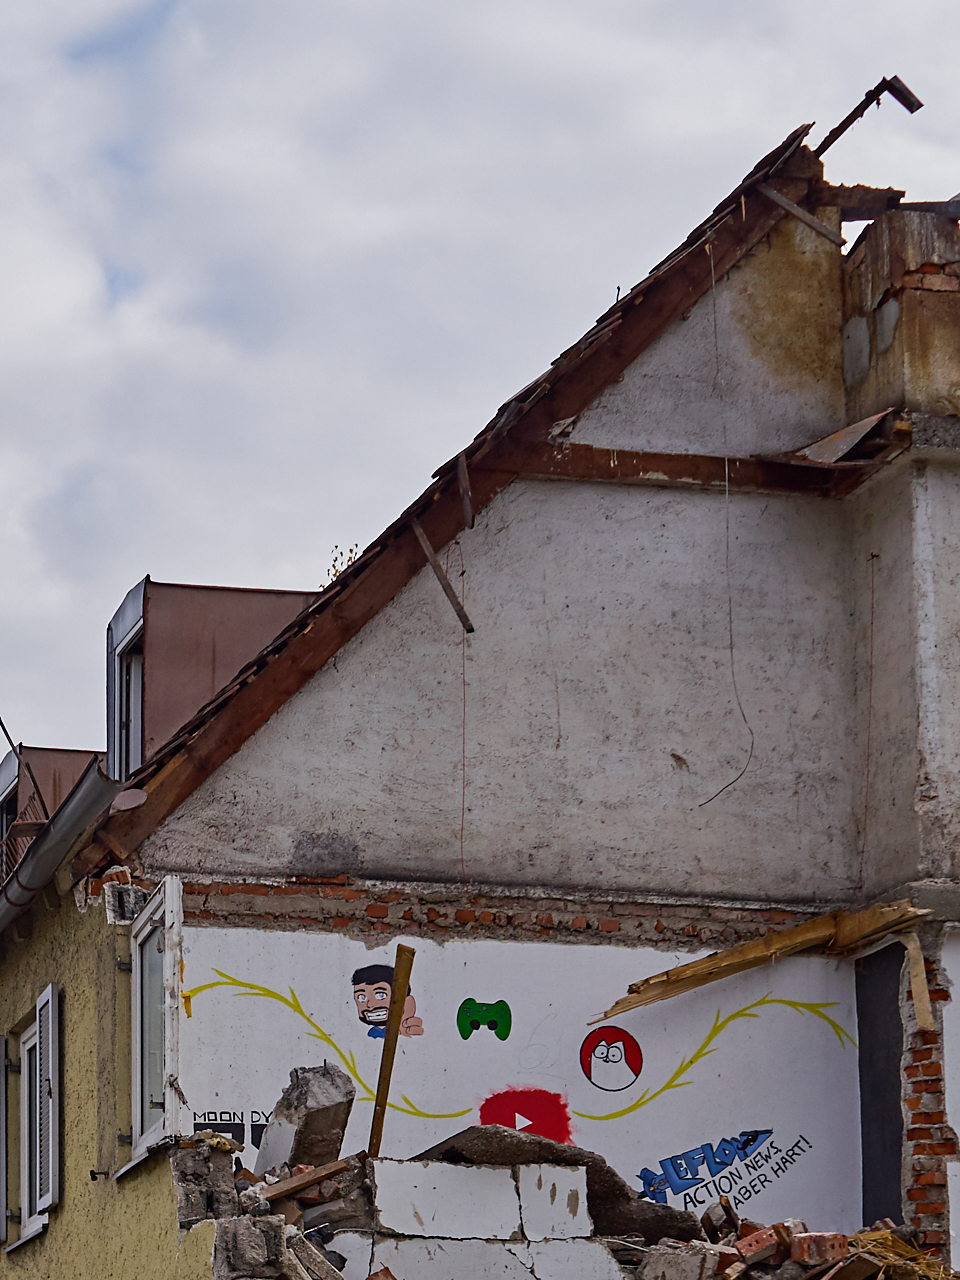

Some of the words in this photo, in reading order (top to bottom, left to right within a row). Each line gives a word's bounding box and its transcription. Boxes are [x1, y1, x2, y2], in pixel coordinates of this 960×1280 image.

[193, 1111, 244, 1123] MOON
[683, 1167, 743, 1211] ACTION
[732, 1172, 773, 1210] ABER
[770, 1134, 813, 1179] HART!
